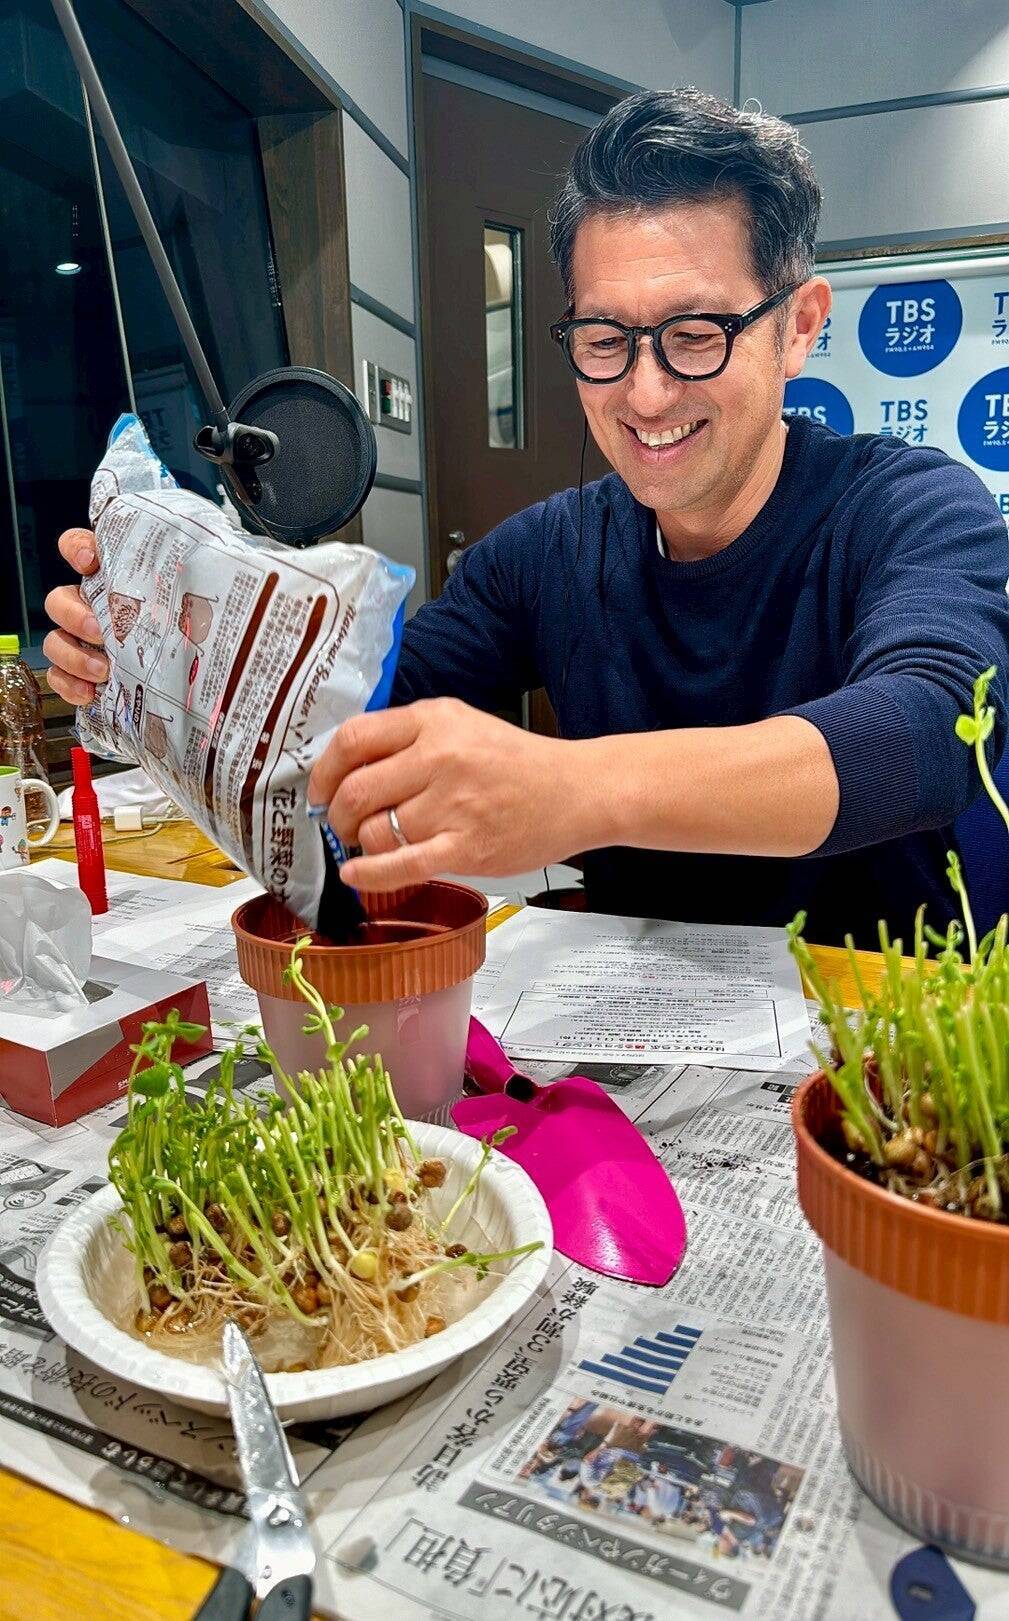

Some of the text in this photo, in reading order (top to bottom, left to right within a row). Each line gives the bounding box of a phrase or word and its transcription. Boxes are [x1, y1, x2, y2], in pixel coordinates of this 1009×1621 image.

[885, 297, 936, 325] TBS
[884, 324, 936, 346] ラジオ
[880, 399, 928, 423] TBS
[474, 1491, 734, 1601] ヴィーガンやベジタリアン
